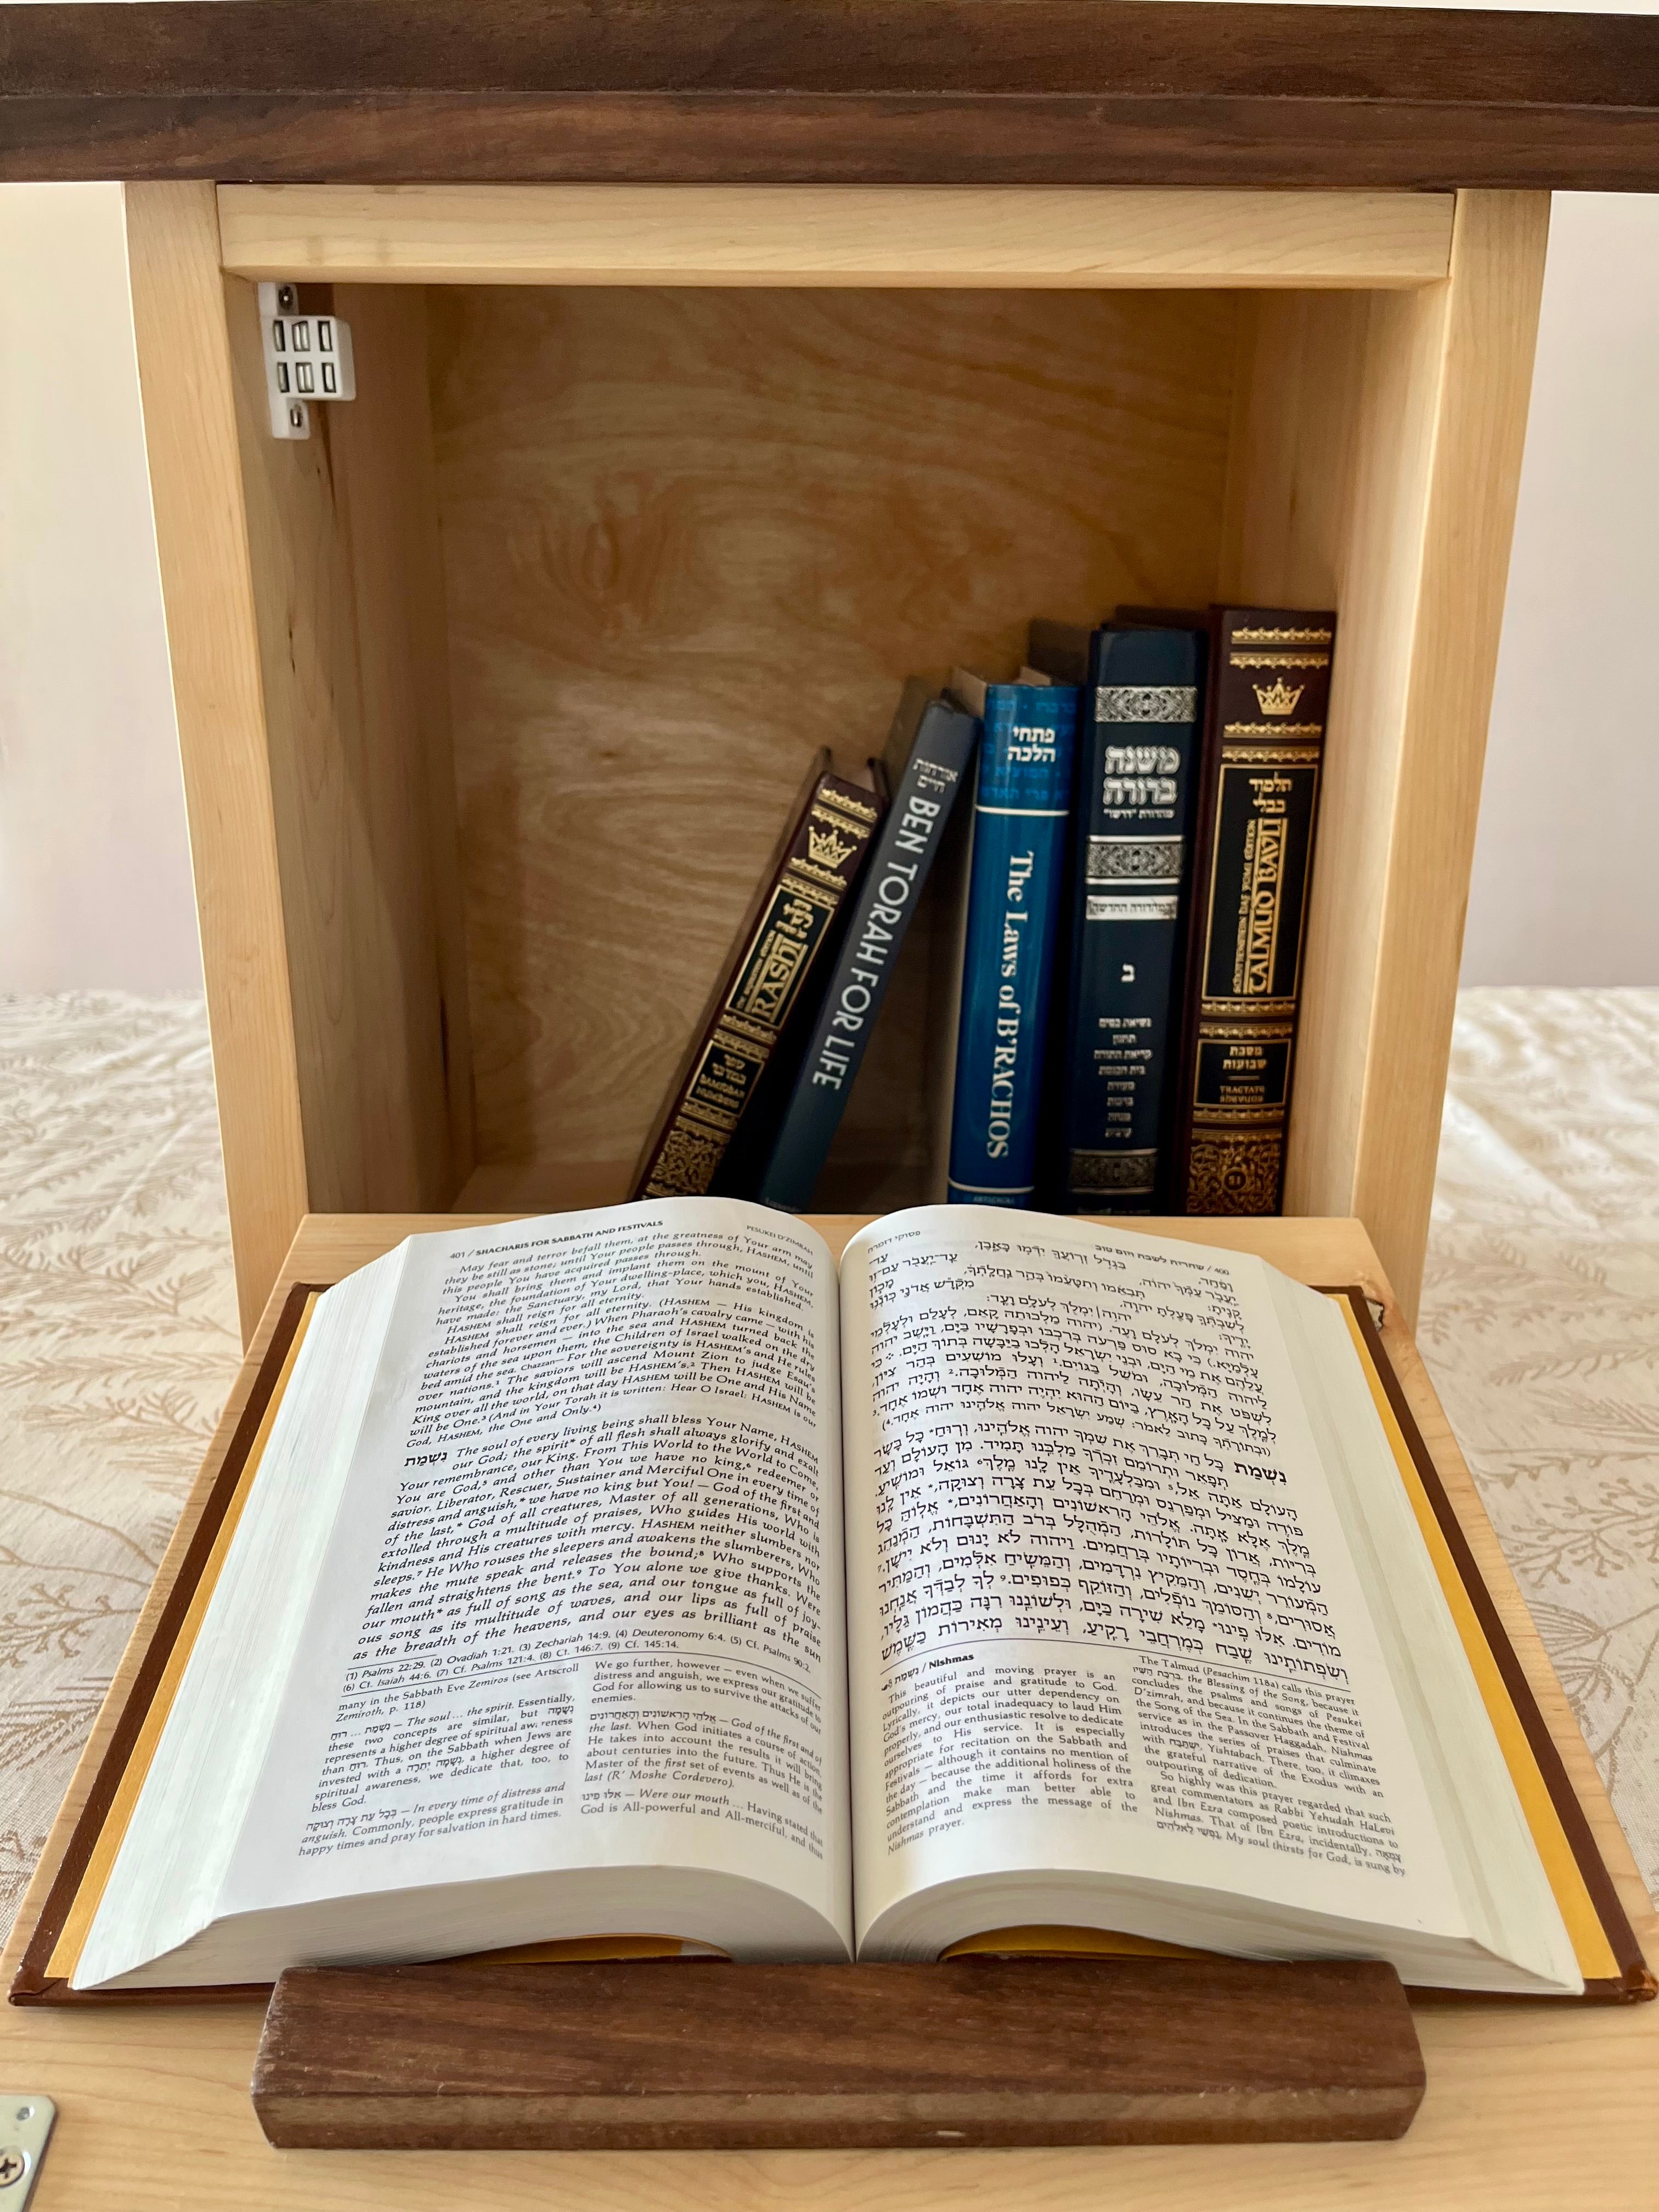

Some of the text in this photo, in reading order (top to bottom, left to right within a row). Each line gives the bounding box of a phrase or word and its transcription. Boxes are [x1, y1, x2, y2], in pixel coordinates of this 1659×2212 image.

[1013, 725, 1056, 743] פתחי
[1007, 743, 1056, 763] הלכה
[1104, 746, 1181, 775] משנה
[1103, 776, 1178, 805] ברורה
[1249, 771, 1292, 793] תלמוד
[1252, 791, 1286, 814] בבלי
[1007, 850, 1035, 902] The
[1248, 818, 1282, 994] TALMUD BAVLI
[812, 796, 940, 1090] BEN TORAH FOR LIFE
[1001, 910, 1029, 978] Laws
[998, 985, 1022, 1015] of
[1222, 1059, 1268, 1071] שבועות
[1230, 1046, 1263, 1057] מסכת
[449, 1220, 663, 1259] 401 SHACHARIS FOR SABBATH AND FESTIVALS
[747, 1225, 776, 1238] PESUKEI
[1095, 1244, 1113, 1253] טוב
[1137, 1252, 1167, 1263] לשבת
[1214, 1267, 1229, 1276] 400
[447, 1293, 644, 1334] HASHEM shall reign for all eternity.
[456, 1446, 479, 1458] The
[481, 1438, 509, 1453] soul
[510, 1435, 525, 1448] of
[526, 1431, 560, 1444] every
[563, 1424, 598, 1437] living
[601, 1419, 635, 1430] being
[637, 1414, 669, 1425] shall
[672, 1414, 702, 1425] bless
[706, 1416, 737, 1429] Your
[740, 1421, 777, 1442] Name,
[780, 1434, 819, 1465] HASHEM
[1034, 1424, 1069, 1437] יהוה
[352, 1608, 821, 1663] as the breadth of the heavens, and our eyes as brilliant as the sun
[346, 1672, 358, 1682] (1)
[361, 1667, 394, 1679] Psalms
[430, 1657, 443, 1668] (2)
[447, 1650, 488, 1664] Ovadiah
[519, 1642, 531, 1652] (3)
[534, 1633, 583, 1650] Zechariah
[588, 1630, 611, 1640] 14:9.
[616, 1629, 628, 1639] (4)
[632, 1628, 704, 1641] Deuteronomy
[708, 1632, 726, 1642] 6:4.
[730, 1635, 742, 1646] (5)
[746, 1639, 759, 1650] Cf.
[763, 1644, 791, 1662] Psalms
[929, 1654, 975, 1669] Nishmas
[888, 1690, 907, 1705] This
[914, 1671, 957, 1691] beautiful
[967, 1667, 985, 1678] and
[995, 1665, 1035, 1676] moving
[1043, 1668, 1077, 1678] prayer
[1086, 1670, 1094, 1679] is
[1138, 1655, 1356, 1705] The Talmud (Pesachim 118a) calls this prayer
[335, 1699, 426, 1723] Zemiroth, p. 118)
[591, 1693, 636, 1704] enemies.
[1146, 1759, 1277, 1788] outpouring of dedication.
[298, 1810, 561, 1857] happy times and pray for salvation in hard times.
[888, 1819, 965, 1855] Nishmas prayer.
